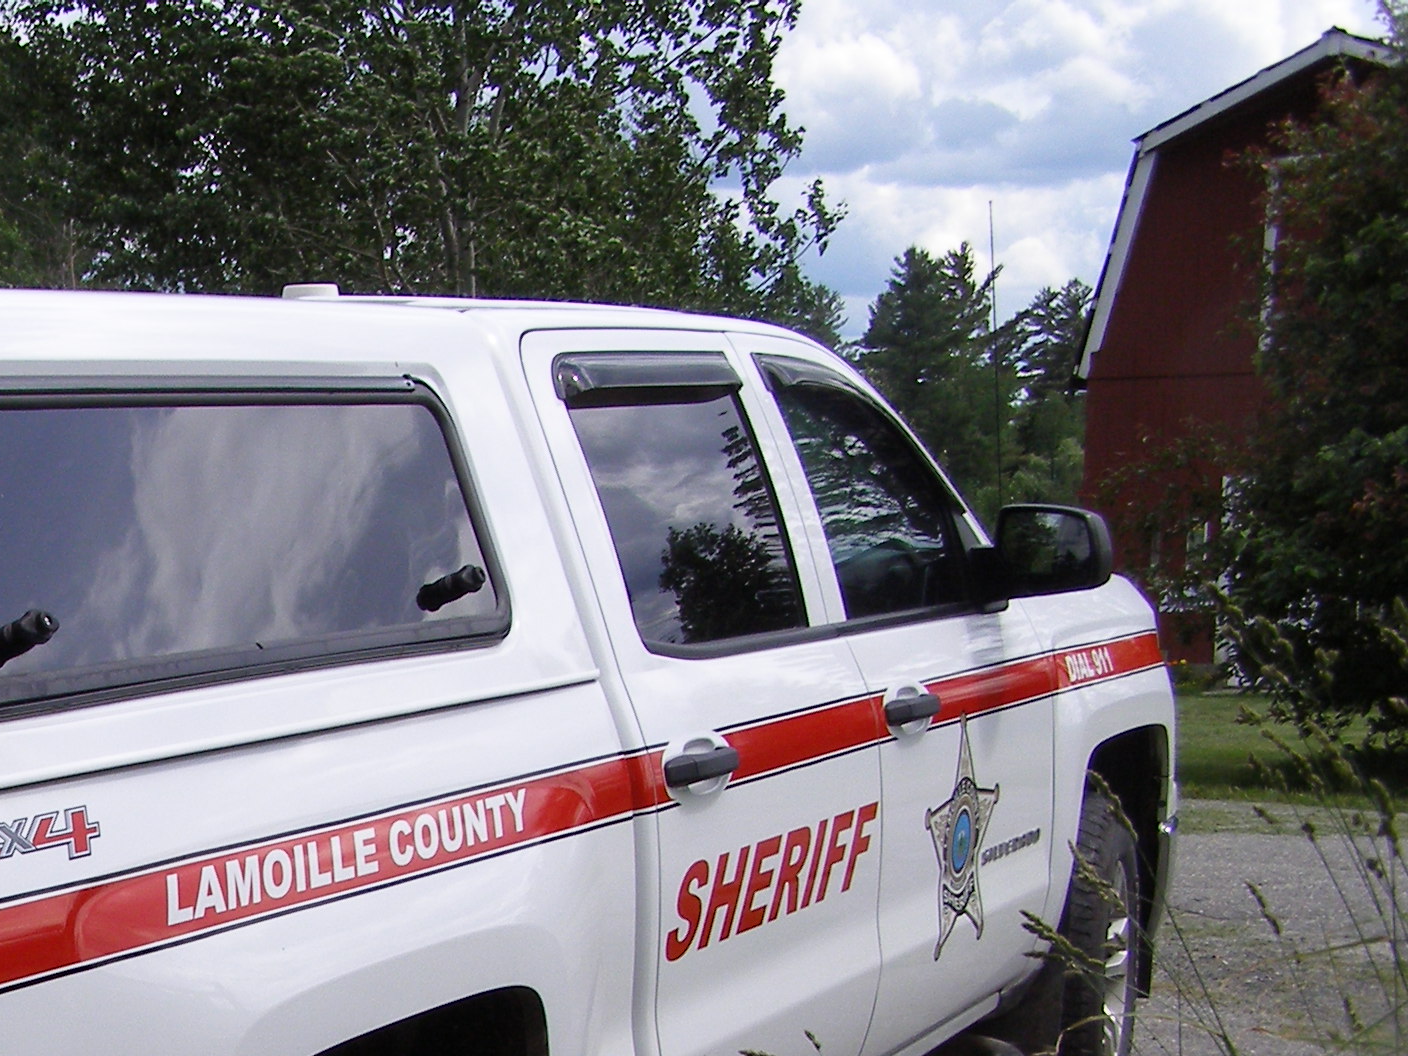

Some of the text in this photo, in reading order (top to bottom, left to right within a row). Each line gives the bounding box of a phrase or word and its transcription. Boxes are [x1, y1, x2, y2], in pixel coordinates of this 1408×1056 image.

[1065, 647, 1114, 682] DIAL 911
[166, 789, 526, 926] LAMOILLE COUNTY
[666, 801, 878, 961] SHERIFF
